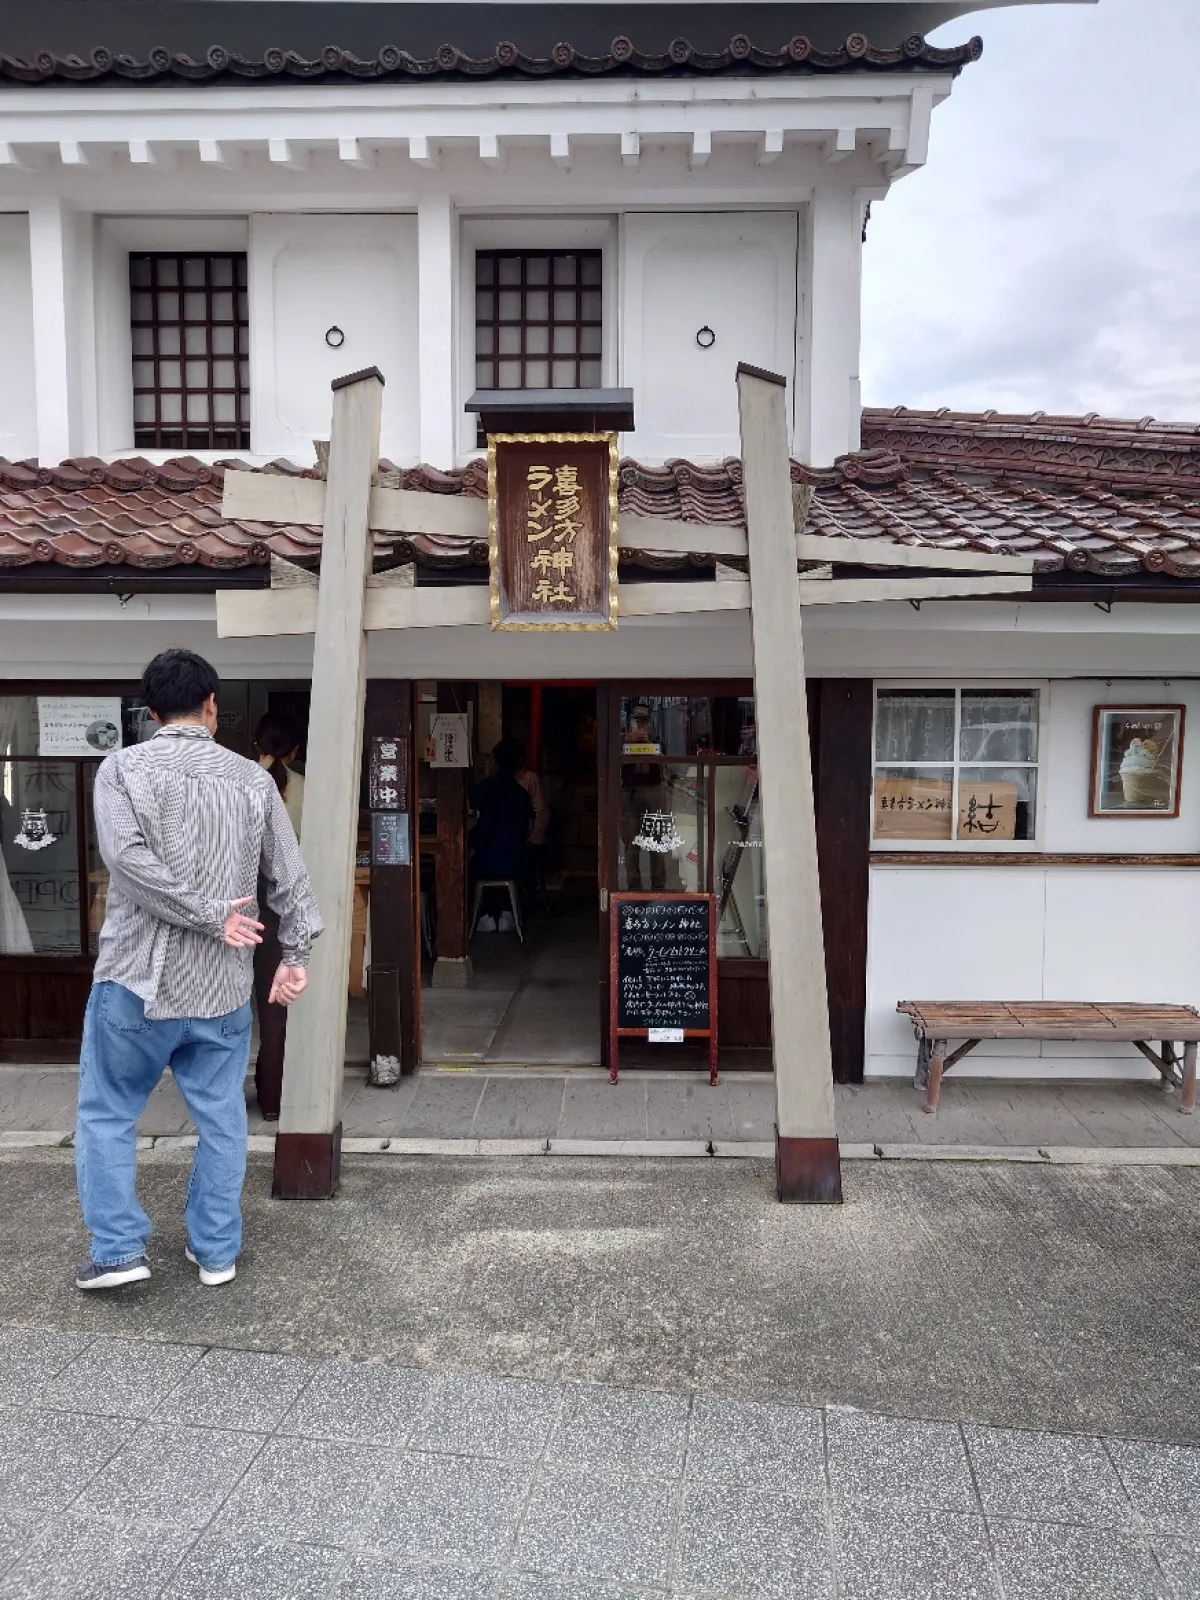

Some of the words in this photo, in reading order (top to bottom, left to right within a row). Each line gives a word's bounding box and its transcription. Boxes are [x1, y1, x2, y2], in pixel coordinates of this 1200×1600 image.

[526, 465, 553, 543] ラーメン
[552, 464, 584, 543] 喜多方
[531, 546, 577, 603] 神社
[379, 742, 398, 804] 営業中
